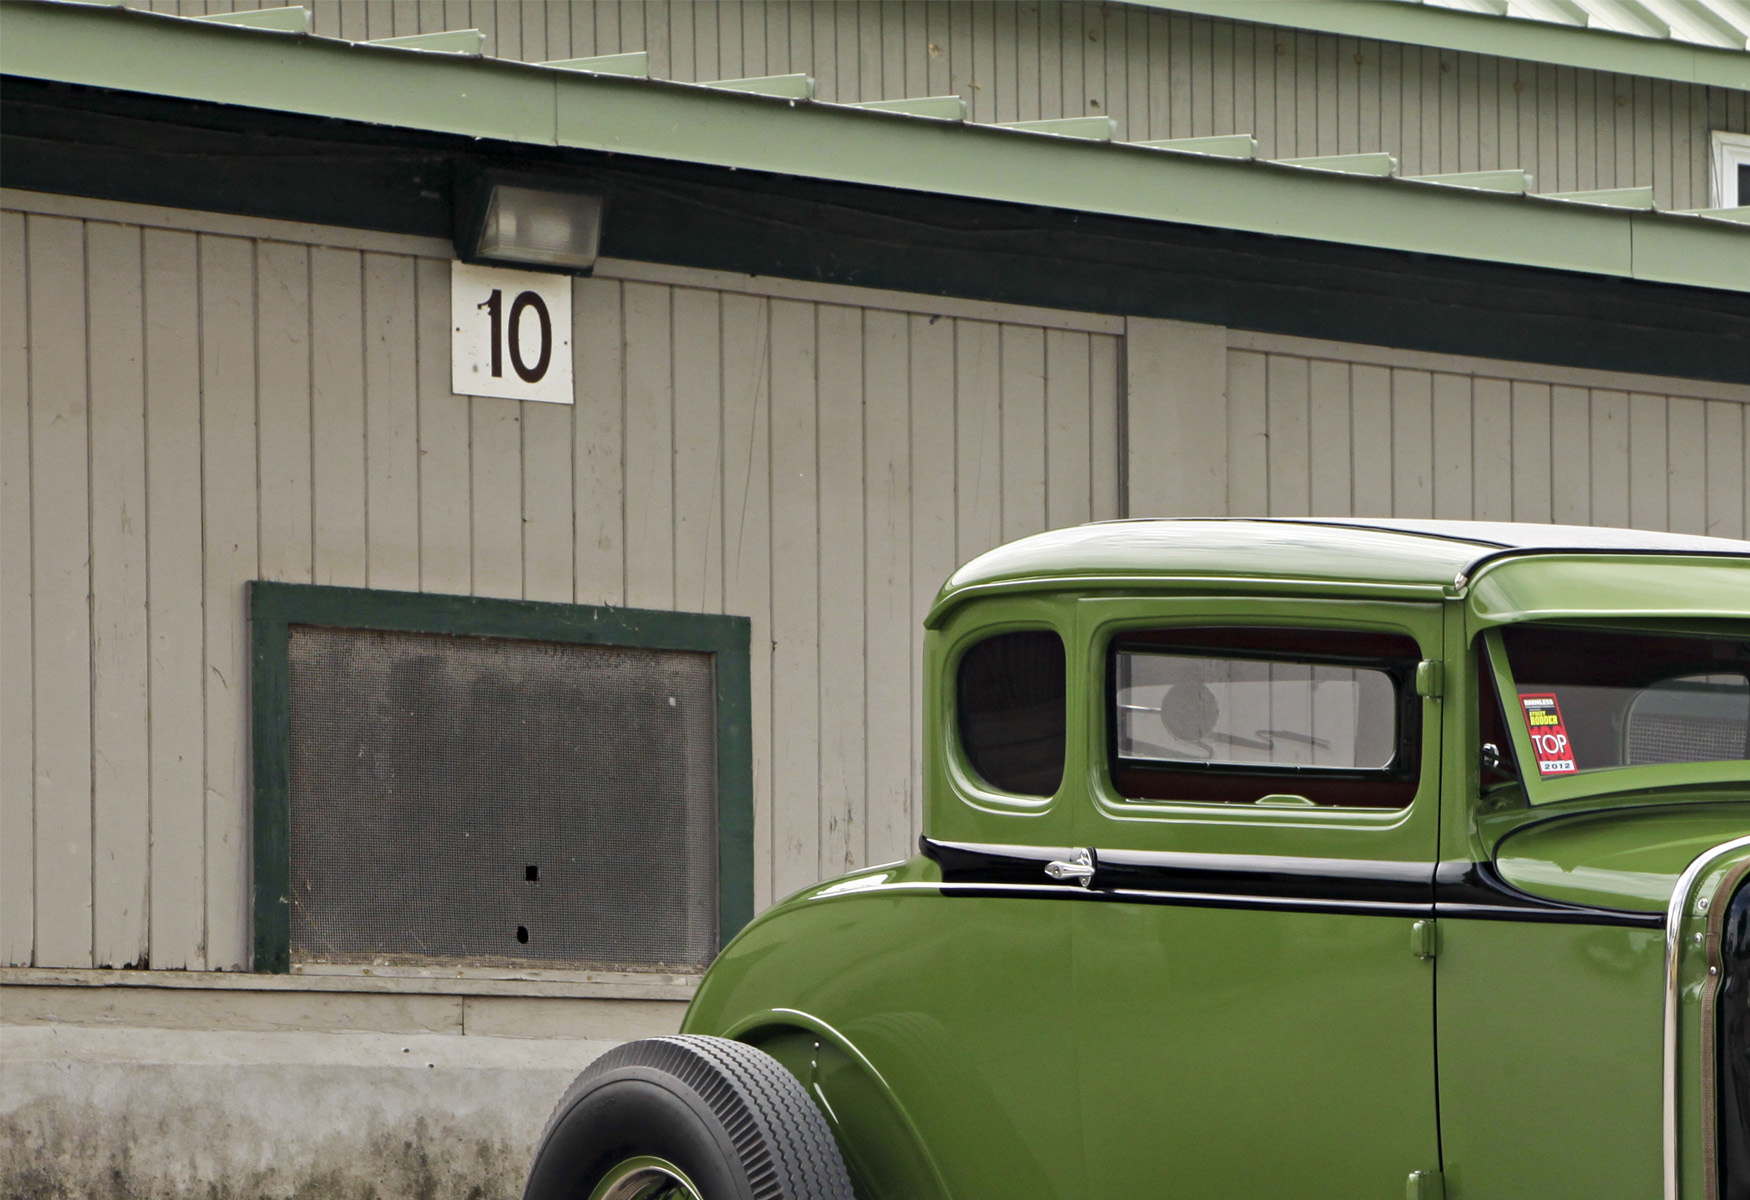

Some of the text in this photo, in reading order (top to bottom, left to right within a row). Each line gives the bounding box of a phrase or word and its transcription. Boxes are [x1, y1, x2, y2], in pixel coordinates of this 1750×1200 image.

[477, 288, 552, 384] 10
[1530, 715, 1559, 726] RODDER
[1531, 734, 1567, 754] TOP
[1544, 762, 1571, 770] 2012
